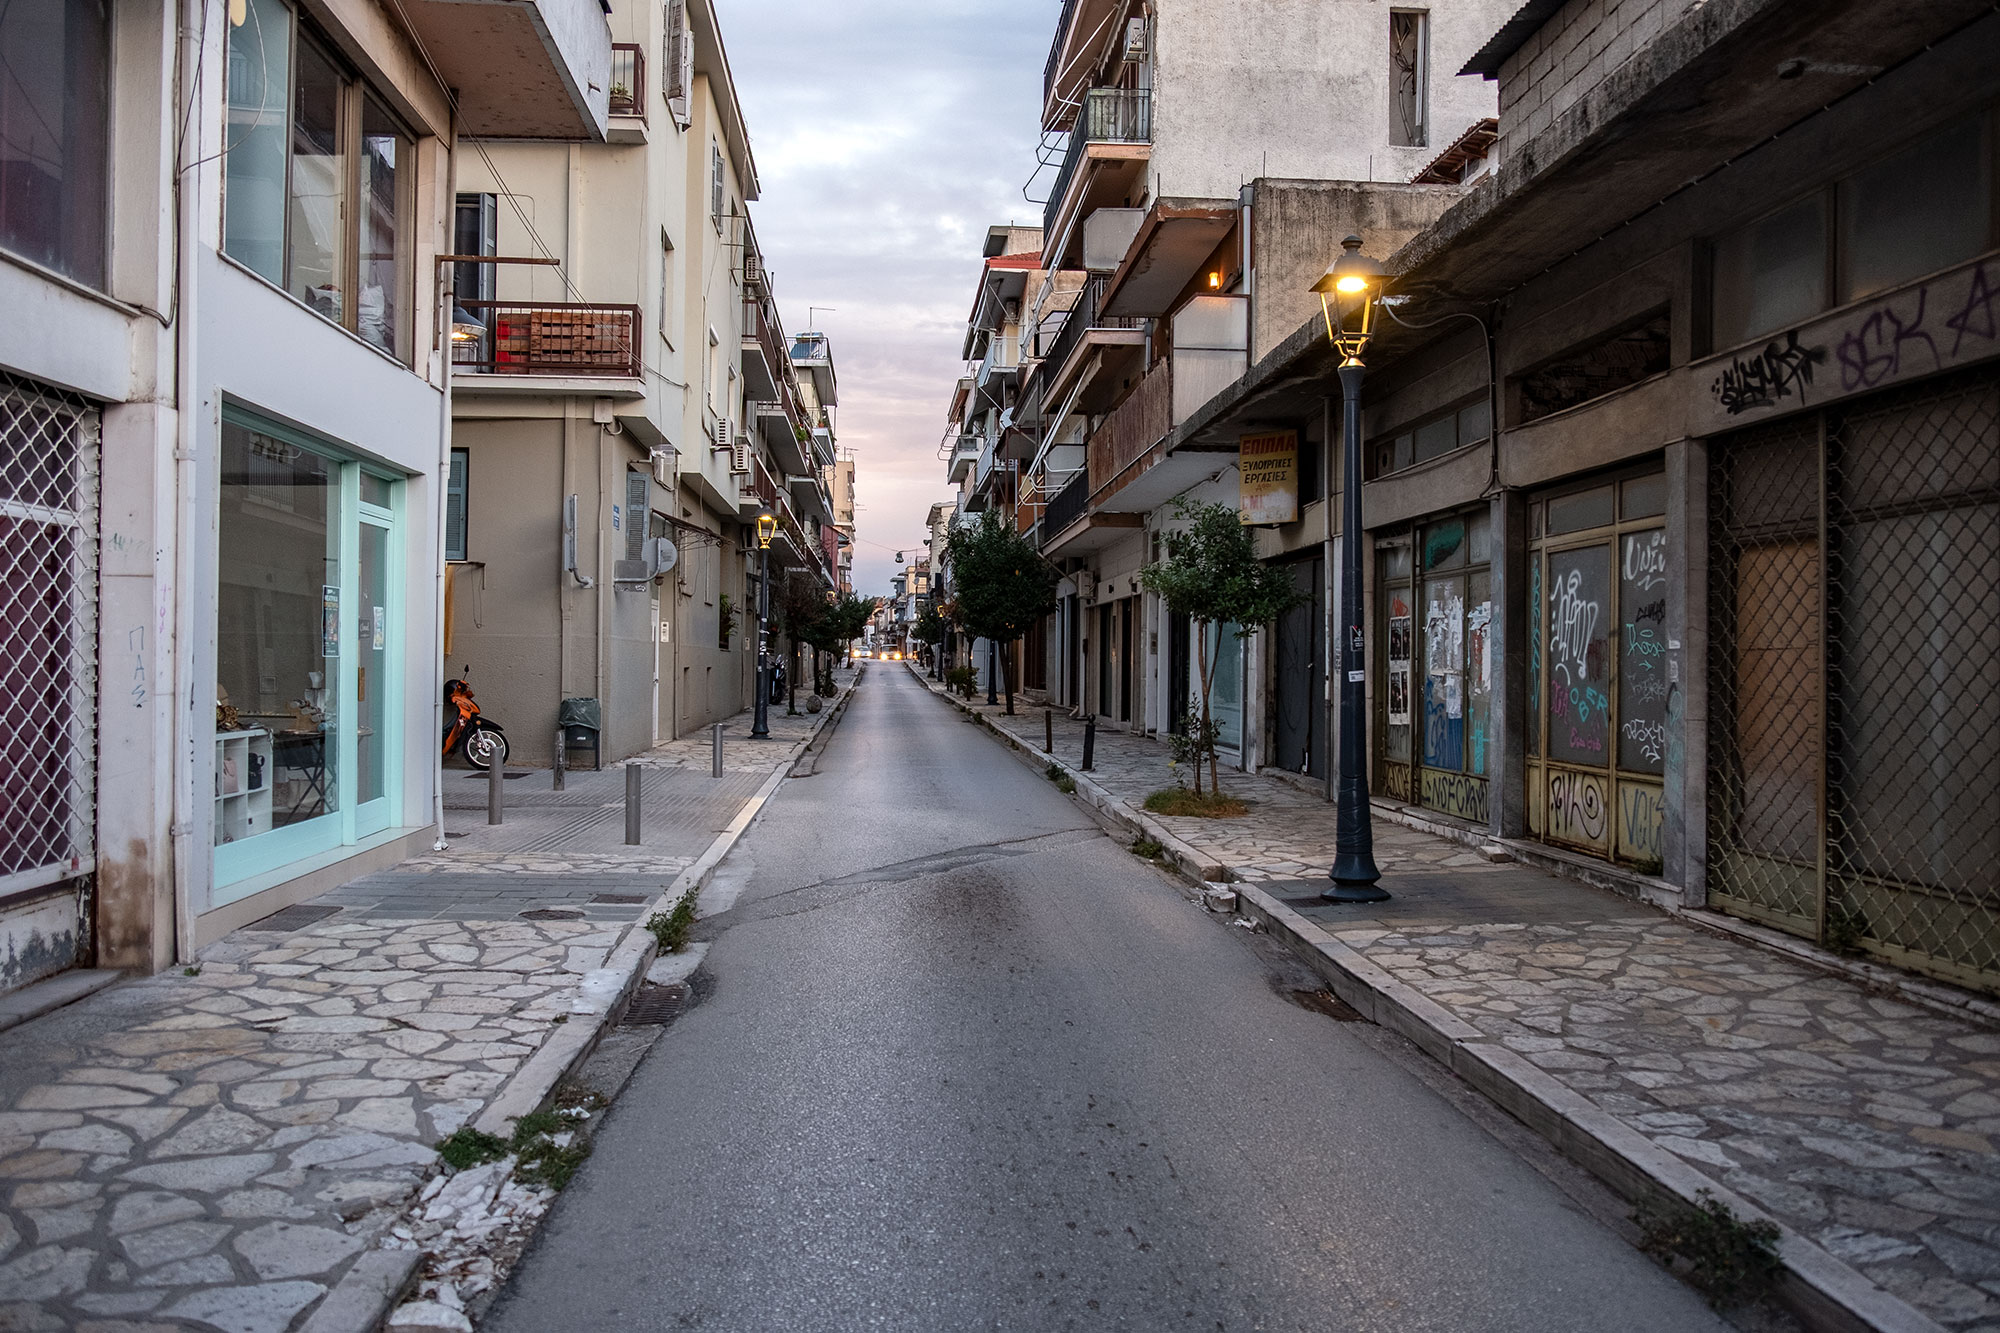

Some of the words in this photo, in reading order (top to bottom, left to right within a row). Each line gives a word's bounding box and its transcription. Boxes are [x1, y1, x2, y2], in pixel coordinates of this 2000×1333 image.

[1242, 435, 1296, 455] ΕΠΙΠΛΑ
[1243, 458, 1292, 471] ΞΥΛΟΥΡΓΙΚΕΣ
[1244, 471, 1287, 484] ΕΡΓΑΣΙΕΣ
